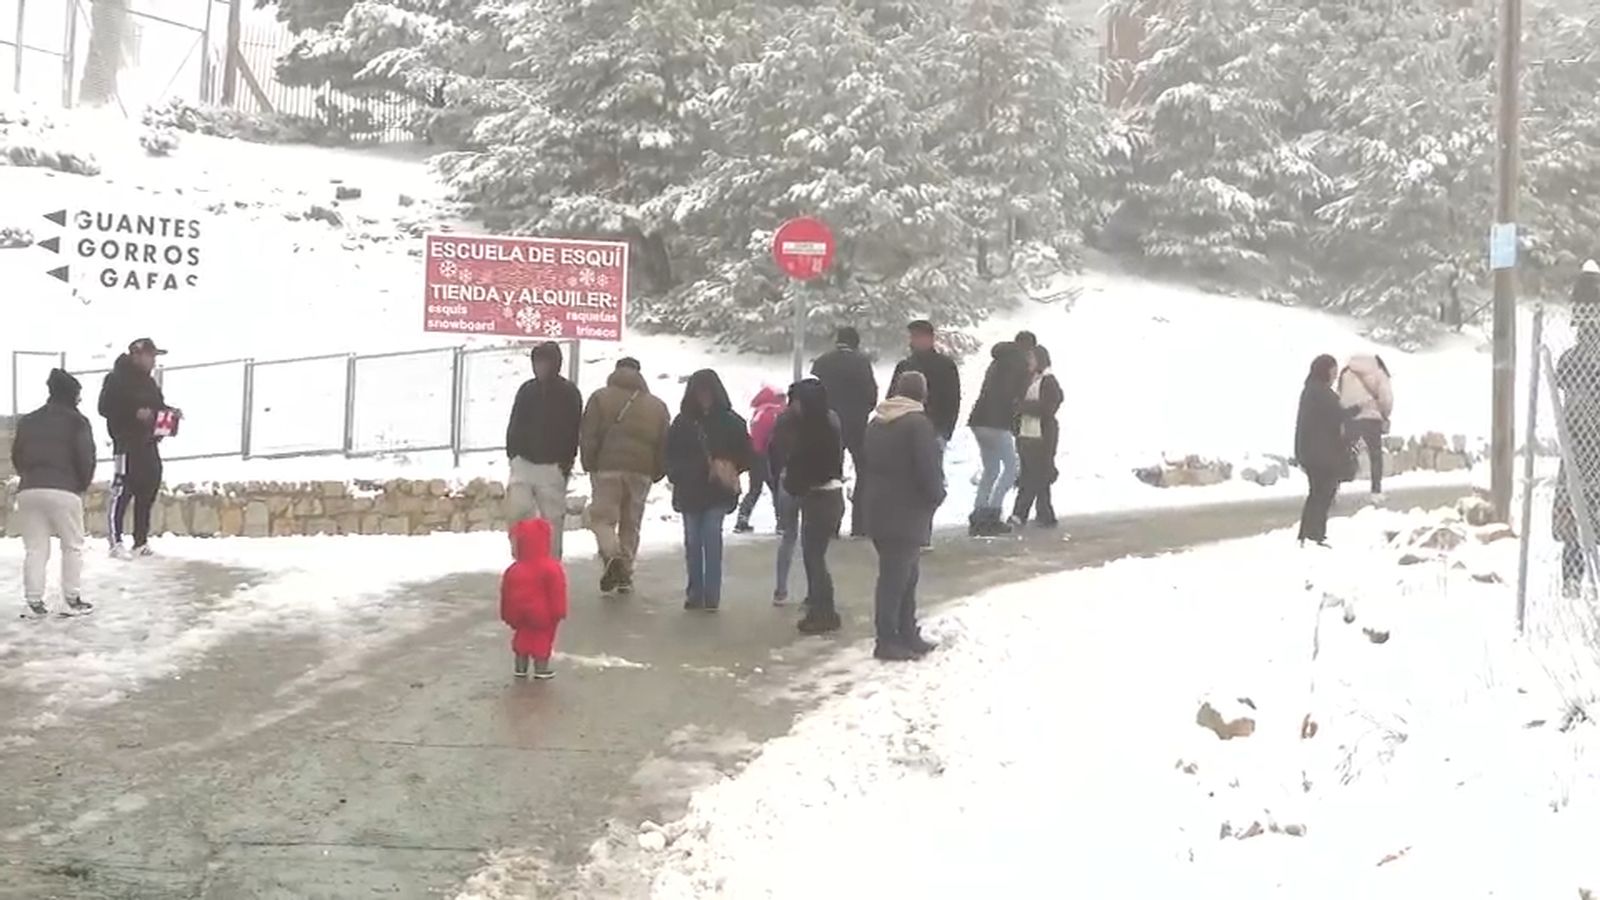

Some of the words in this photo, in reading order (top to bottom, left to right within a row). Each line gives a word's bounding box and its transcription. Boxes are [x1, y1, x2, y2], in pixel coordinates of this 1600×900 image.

[74, 210, 200, 239] GUANTES
[77, 238, 200, 266] GORROS
[431, 242, 526, 262] ESCUELA
[528, 247, 555, 264] DE
[561, 248, 621, 268] ESQUÍ
[430, 284, 500, 302] TIENDA
[503, 290, 516, 306] y
[519, 288, 618, 308] ALQUILER:
[427, 320, 495, 332] snowboard
